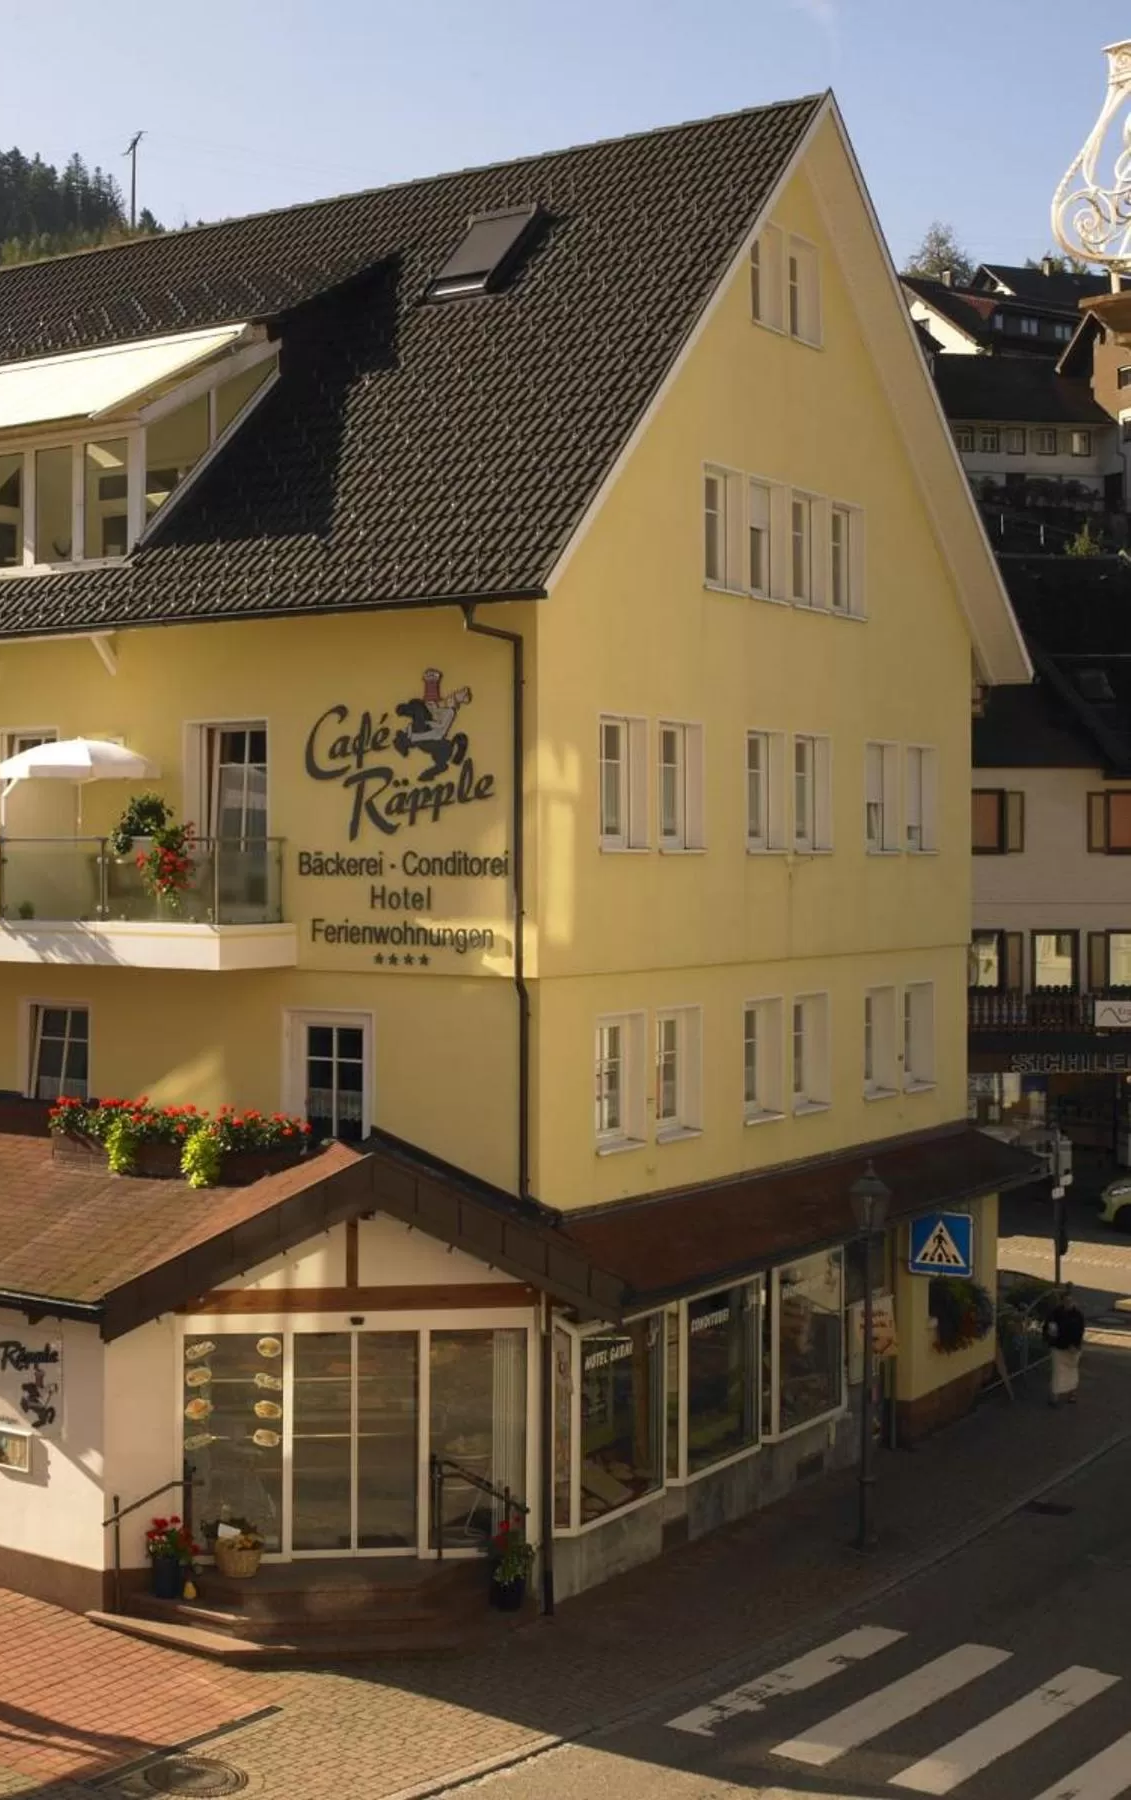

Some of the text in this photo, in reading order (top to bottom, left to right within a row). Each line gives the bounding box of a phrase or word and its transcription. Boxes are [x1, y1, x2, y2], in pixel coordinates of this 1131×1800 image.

[305, 704, 390, 780] Café
[342, 757, 494, 842] Räpple
[298, 850, 509, 876] Bäckerei Conditorei
[370, 885, 431, 911] Hotel
[311, 918, 494, 953] Ferienwohnungen
[1011, 1053, 1131, 1074] SCHILLE
